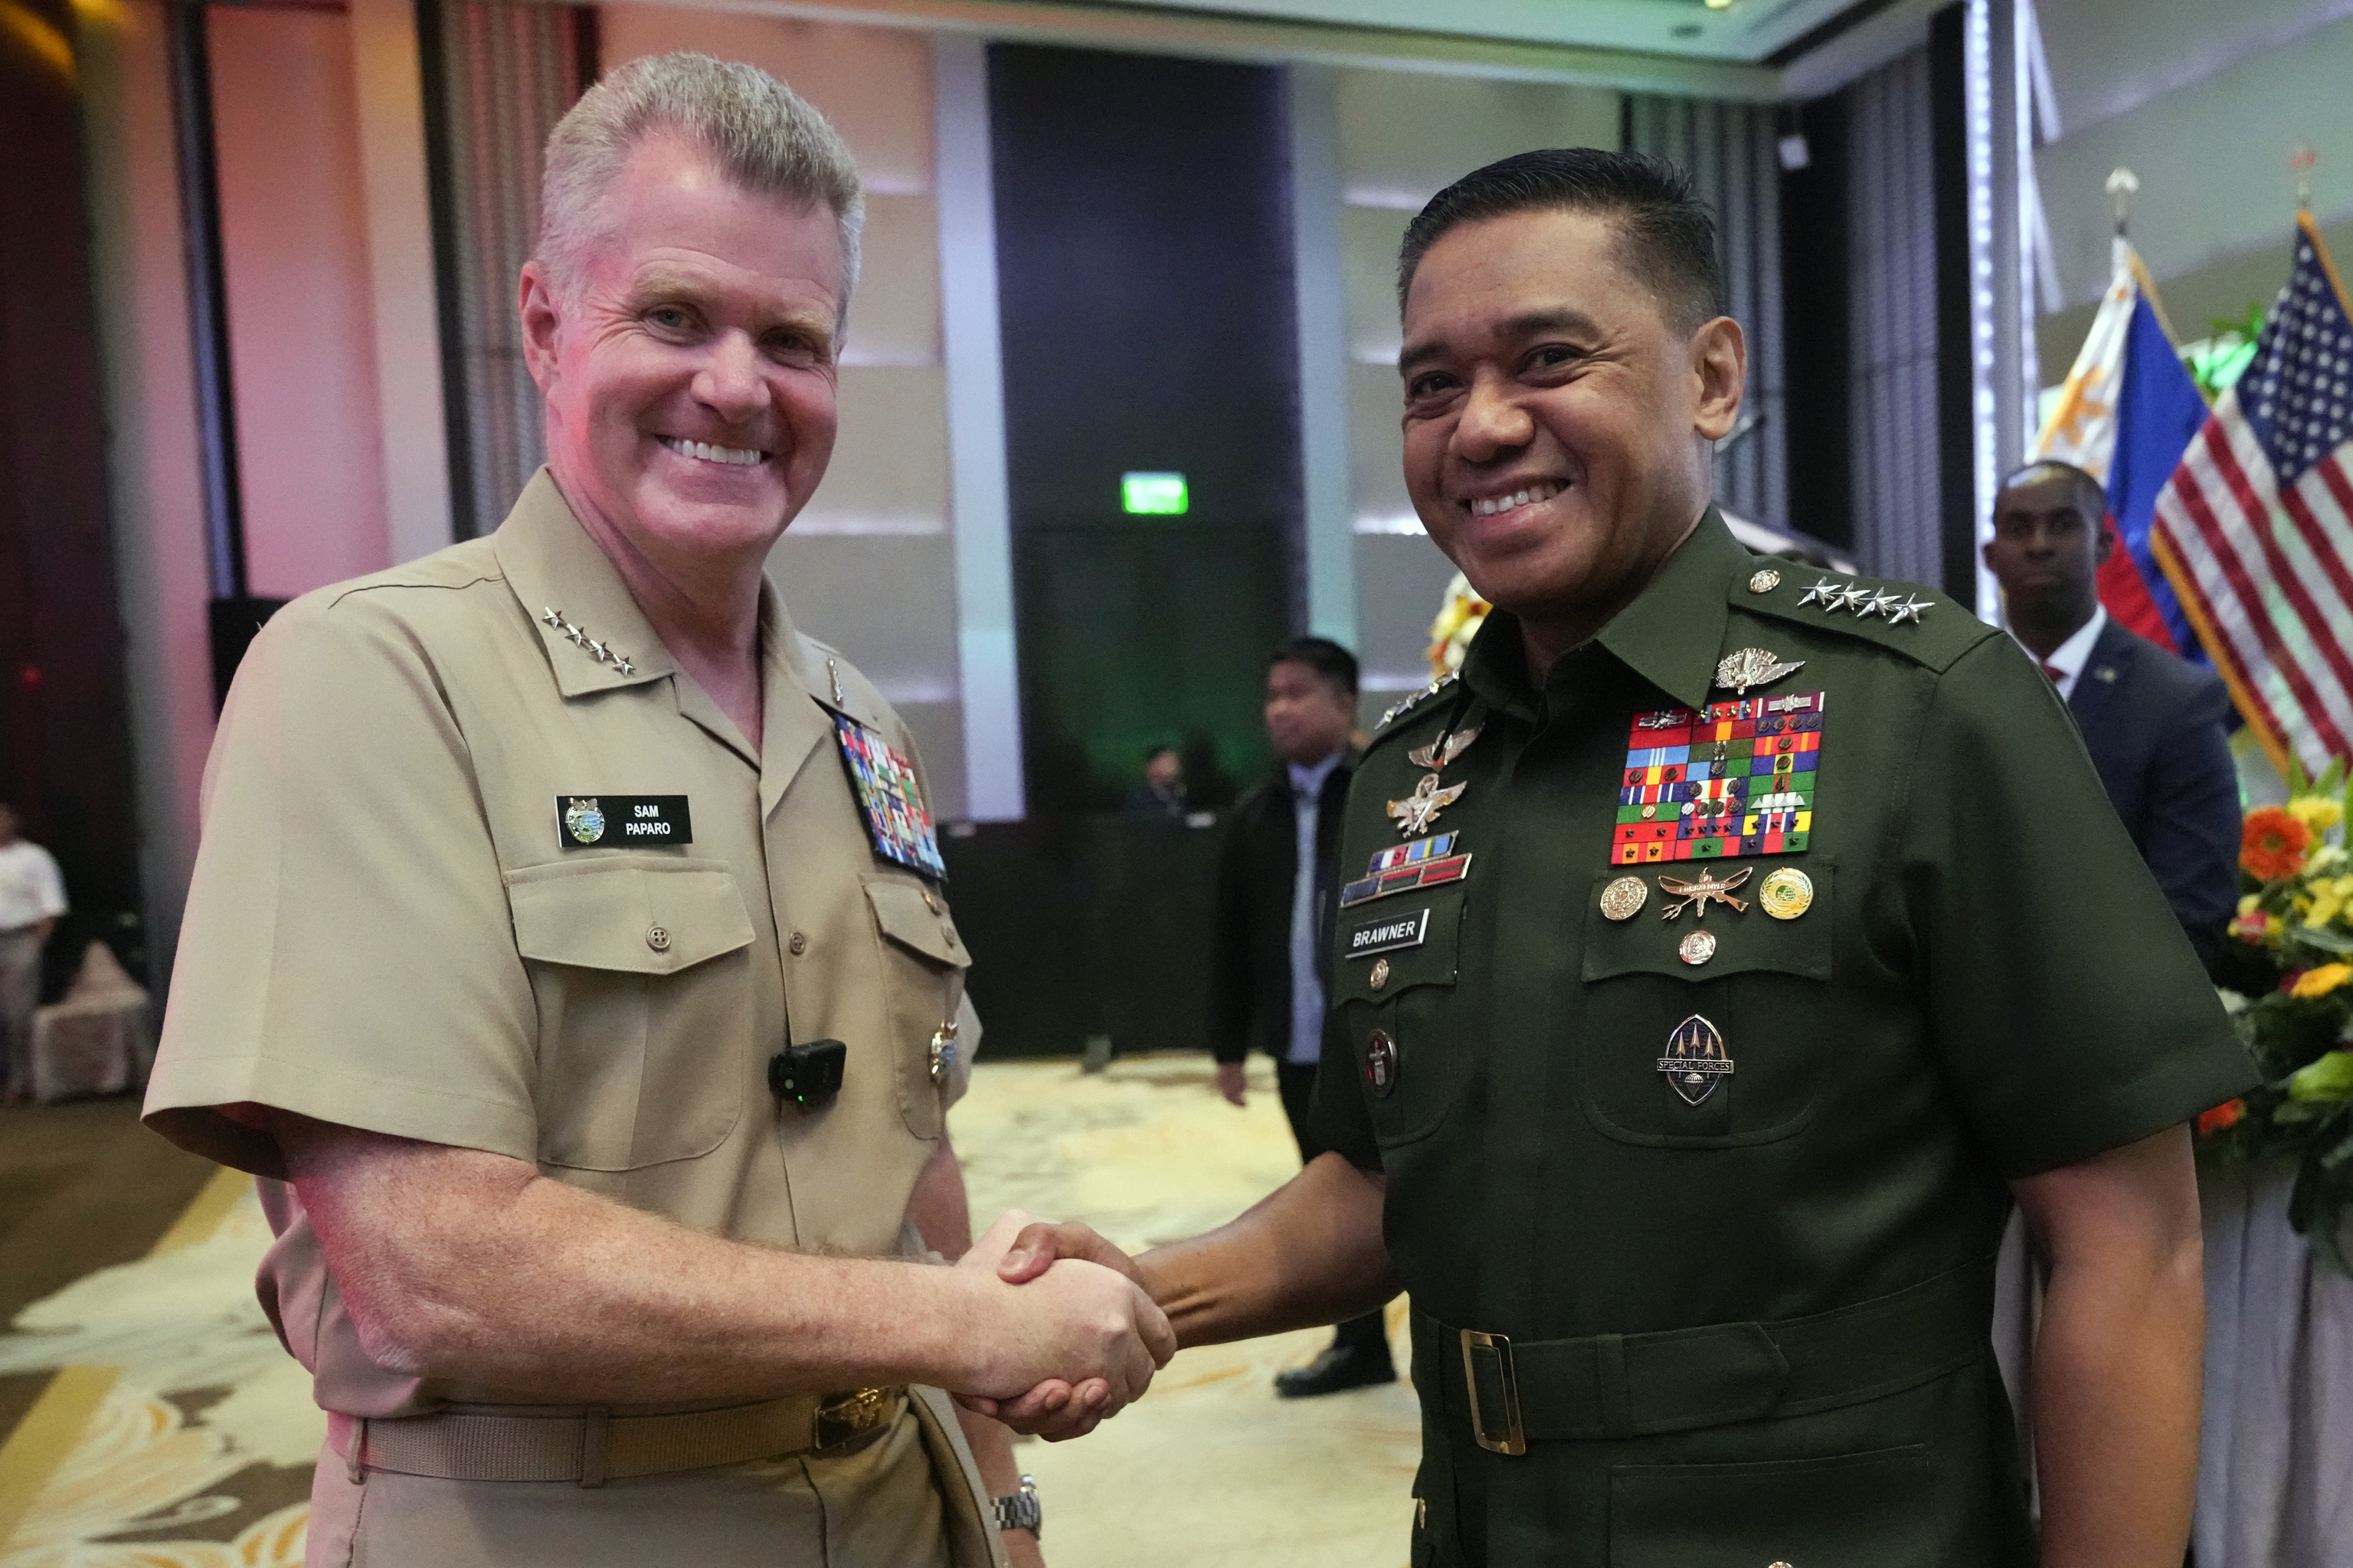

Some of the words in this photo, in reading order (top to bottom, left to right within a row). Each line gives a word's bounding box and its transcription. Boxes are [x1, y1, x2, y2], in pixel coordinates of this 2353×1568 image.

[634, 805, 659, 817] SAM
[626, 822, 671, 835] PAPARO
[1353, 921, 1415, 947] BRAWNER
[1658, 1060, 1694, 1070] SPECIAL
[1697, 1062, 1730, 1071] FORCES
